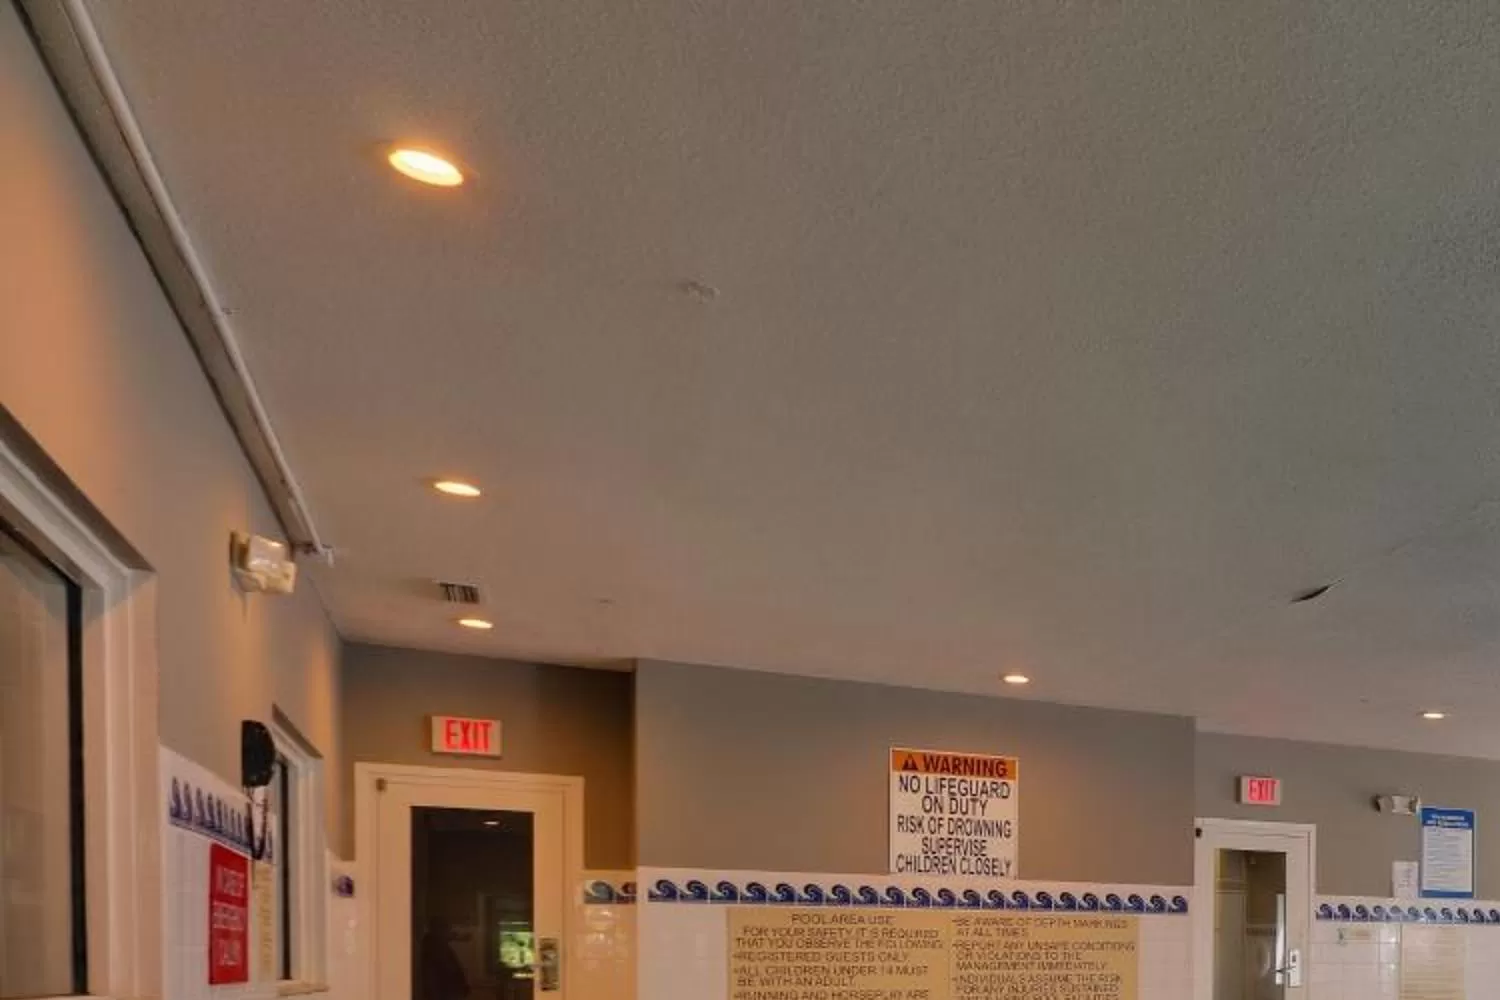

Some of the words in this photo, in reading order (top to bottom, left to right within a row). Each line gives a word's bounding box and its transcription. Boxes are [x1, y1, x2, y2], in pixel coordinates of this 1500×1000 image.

[445, 719, 493, 752] EXIT
[923, 754, 1008, 777] WARNING
[899, 775, 921, 793] NO
[925, 777, 1010, 799] LIFEGUARD
[1249, 779, 1277, 801] EXIT
[922, 796, 944, 814] ON
[949, 797, 988, 816] DUTY
[897, 815, 925, 834] RISK
[928, 817, 944, 835] OF
[948, 818, 1012, 838] DROWNING
[922, 837, 988, 857] SUPERVISE
[896, 854, 957, 875] CHILDREN
[961, 858, 1011, 877] CLOSELY
[791, 913, 831, 925] POOL
[832, 914, 866, 925] AREA
[869, 915, 896, 925] USE
